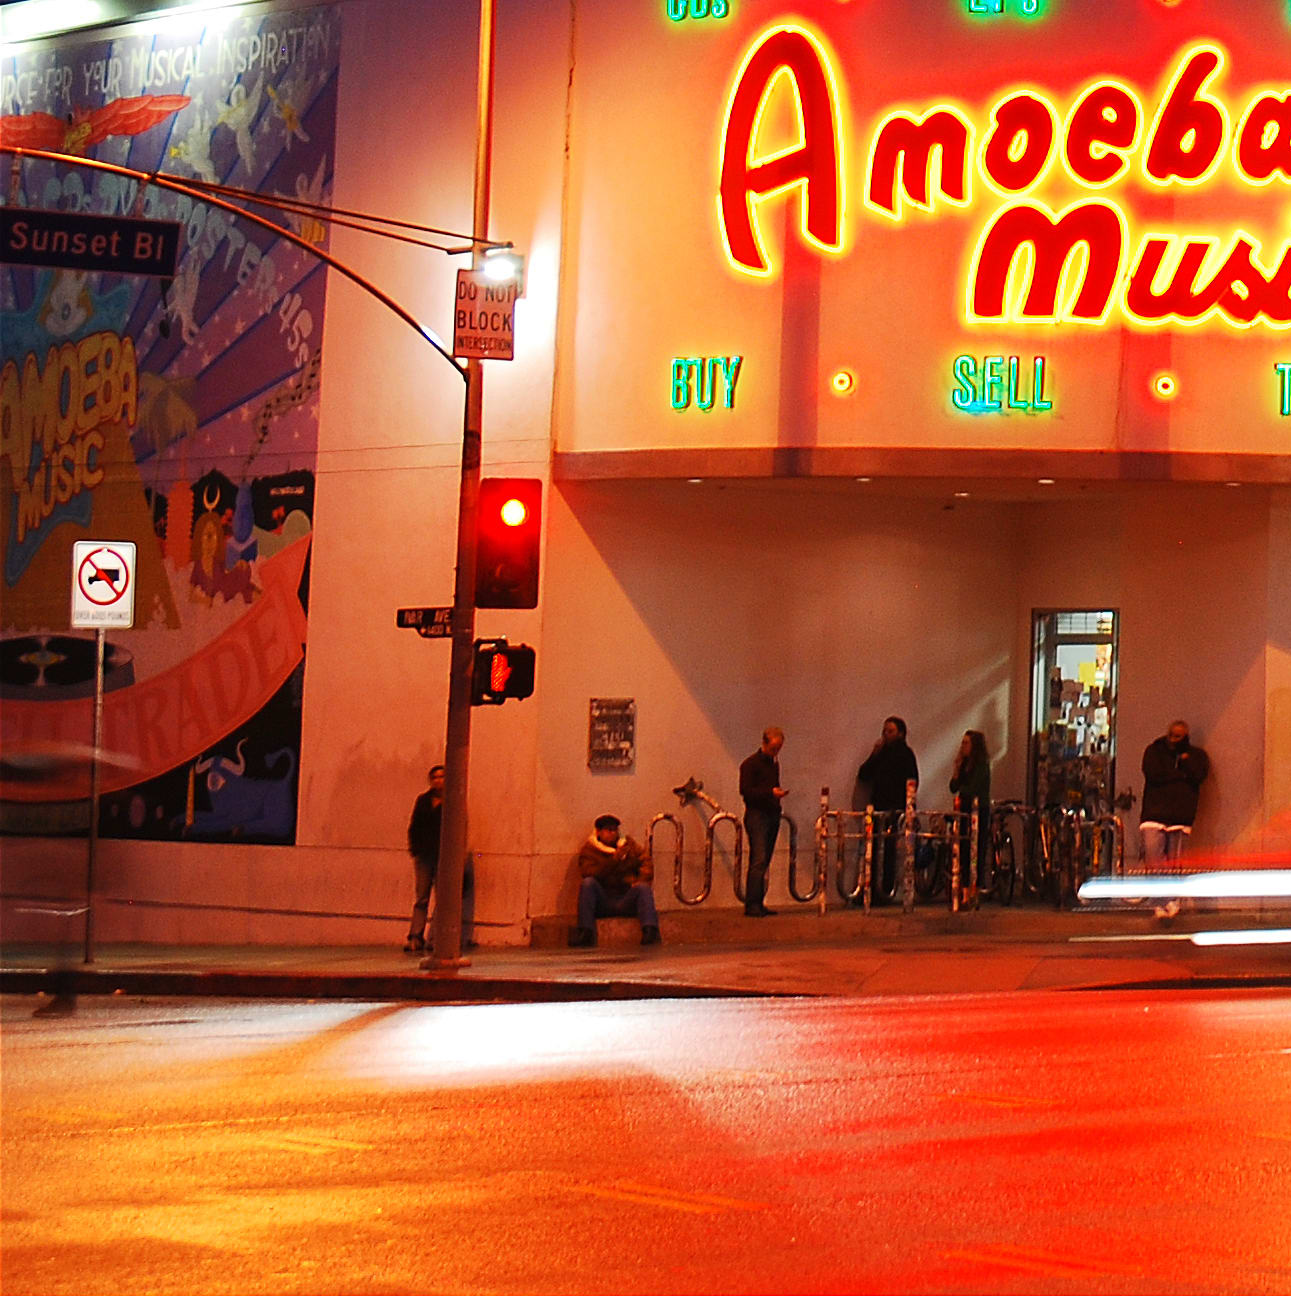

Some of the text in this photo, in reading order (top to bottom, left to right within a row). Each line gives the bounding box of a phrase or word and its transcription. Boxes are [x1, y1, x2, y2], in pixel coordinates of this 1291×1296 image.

[130, 40, 207, 90] MUSICAL
[9, 220, 165, 261] Sunset Bl
[458, 280, 518, 303] DO NOT
[456, 309, 513, 332] BLOCK
[670, 354, 744, 413] BUY
[951, 354, 1054, 415] SELL
